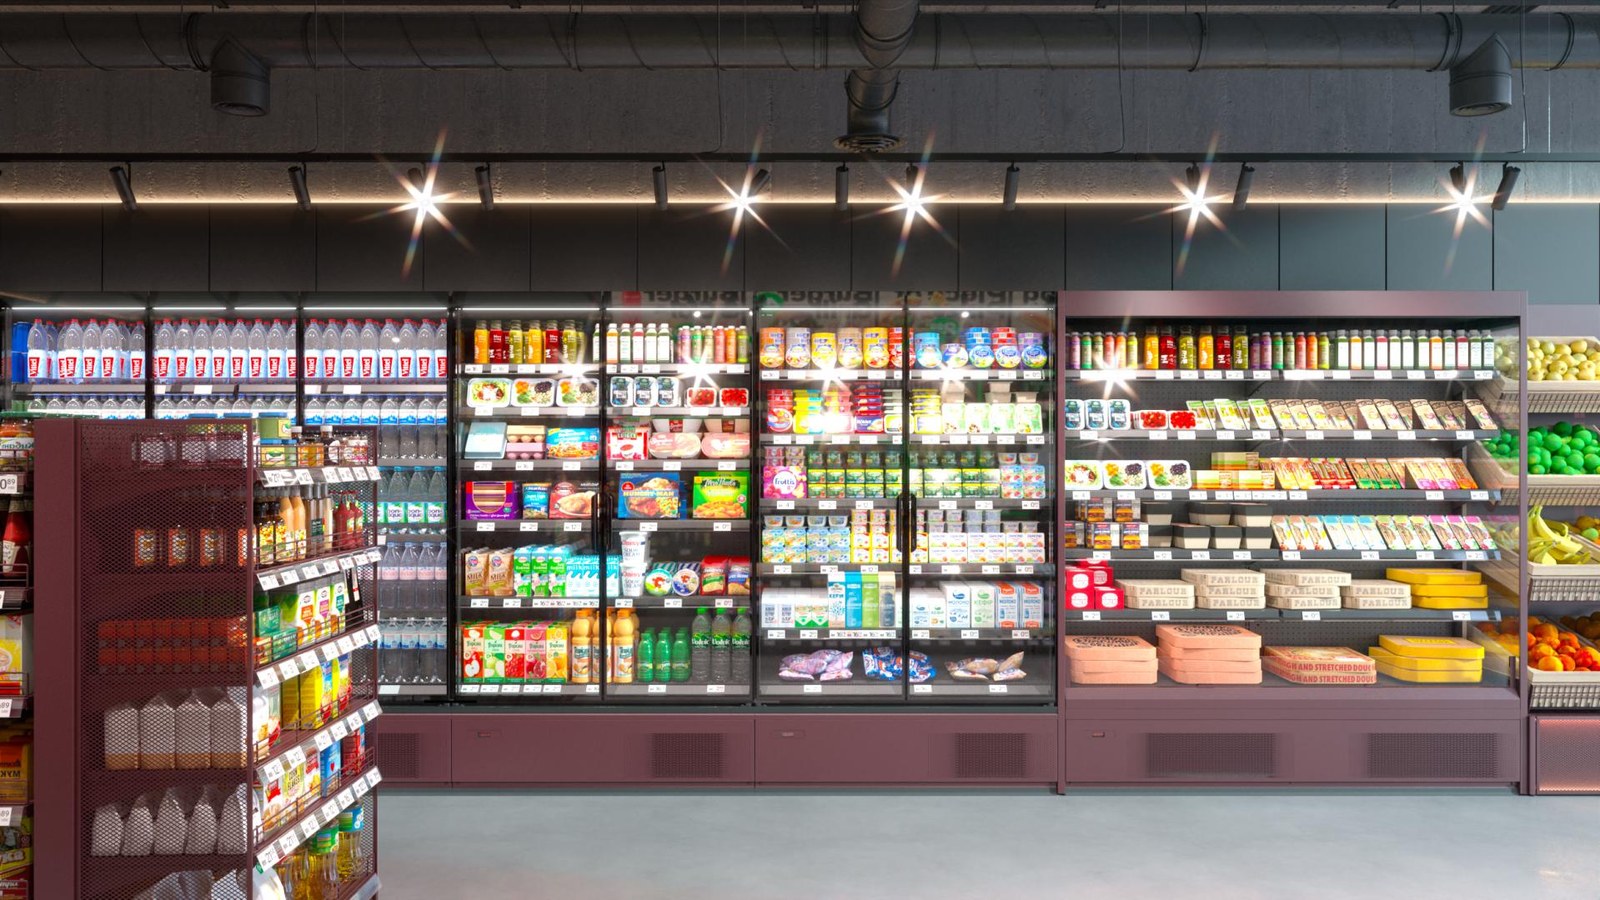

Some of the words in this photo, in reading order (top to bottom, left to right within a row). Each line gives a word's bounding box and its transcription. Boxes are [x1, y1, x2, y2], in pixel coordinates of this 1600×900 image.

[467, 573, 483, 581] MILK
[490, 573, 506, 581] MILK
[1210, 576, 1258, 584] PARLOUR
[1301, 576, 1346, 584] PARLOUR
[1139, 587, 1187, 595] PARLOUR
[1208, 587, 1256, 595] PARLOUR
[1284, 587, 1333, 595] PARLOUR
[1356, 587, 1404, 595] PARLOUR
[1142, 599, 1189, 607] PARLOUR
[1212, 599, 1260, 607] PARLOUR
[1294, 599, 1338, 607] PARLOUR
[1362, 599, 1408, 607] PARLOUR
[1304, 674, 1318, 682] AND
[1320, 674, 1356, 682] STRETCHED
